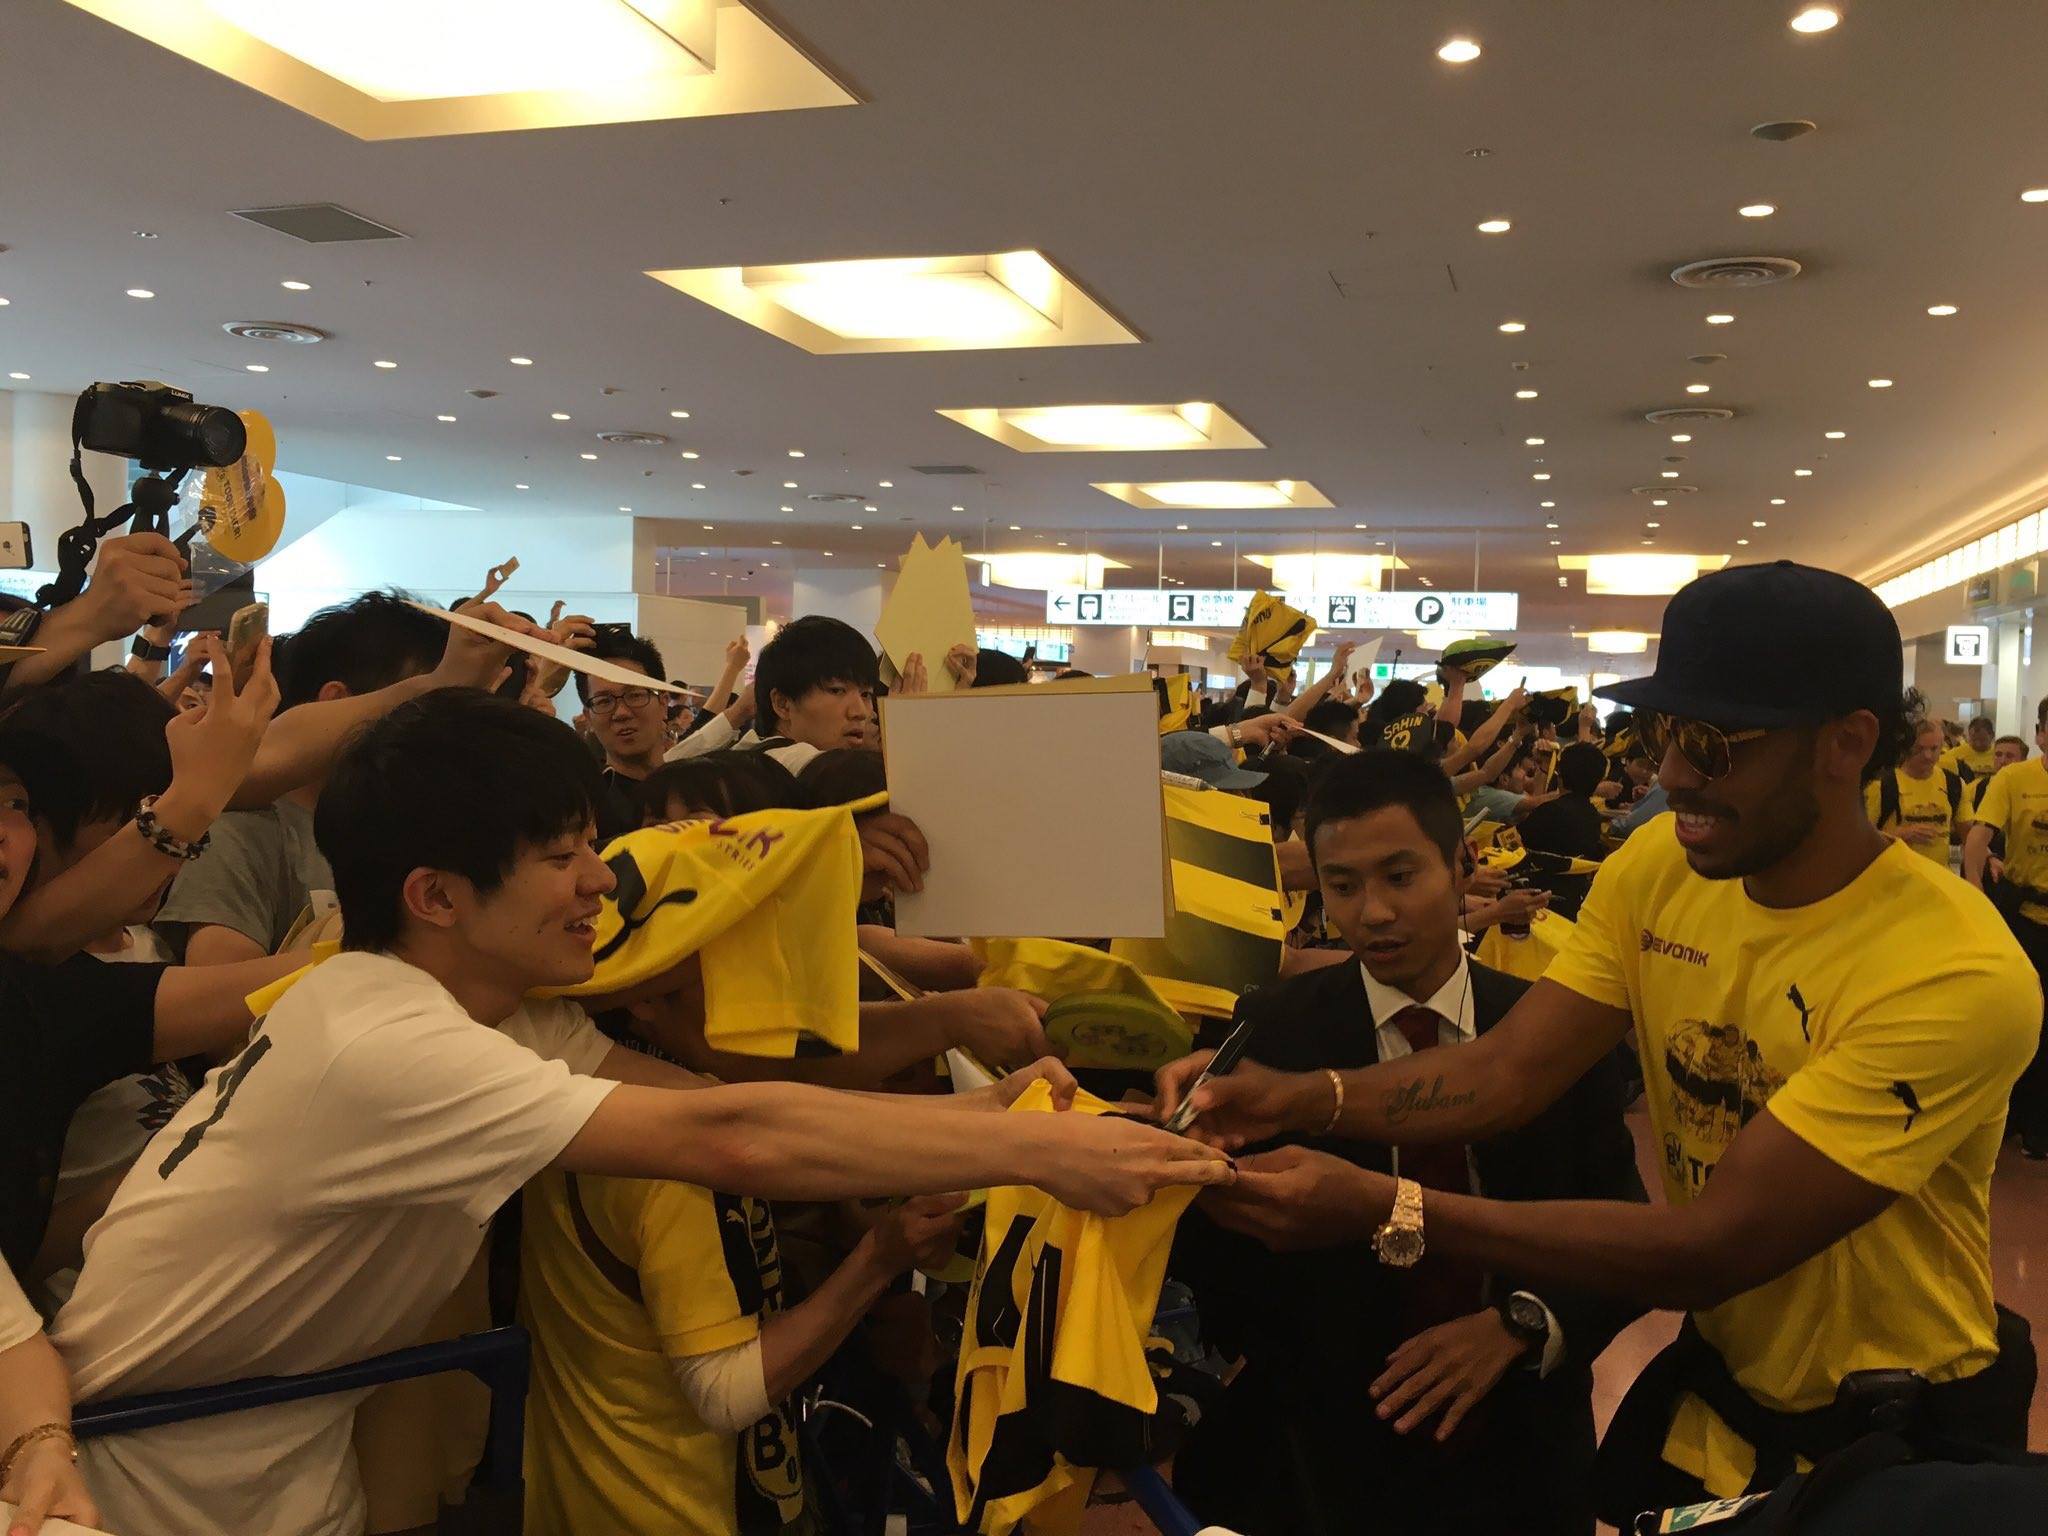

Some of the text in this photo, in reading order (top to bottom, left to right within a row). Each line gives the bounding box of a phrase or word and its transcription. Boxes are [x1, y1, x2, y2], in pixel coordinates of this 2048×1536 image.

[1330, 596, 1355, 606] TAXI
[1421, 599, 1440, 622] P
[1383, 716, 1423, 740] SAHIN
[1652, 936, 1710, 968] EVONIK
